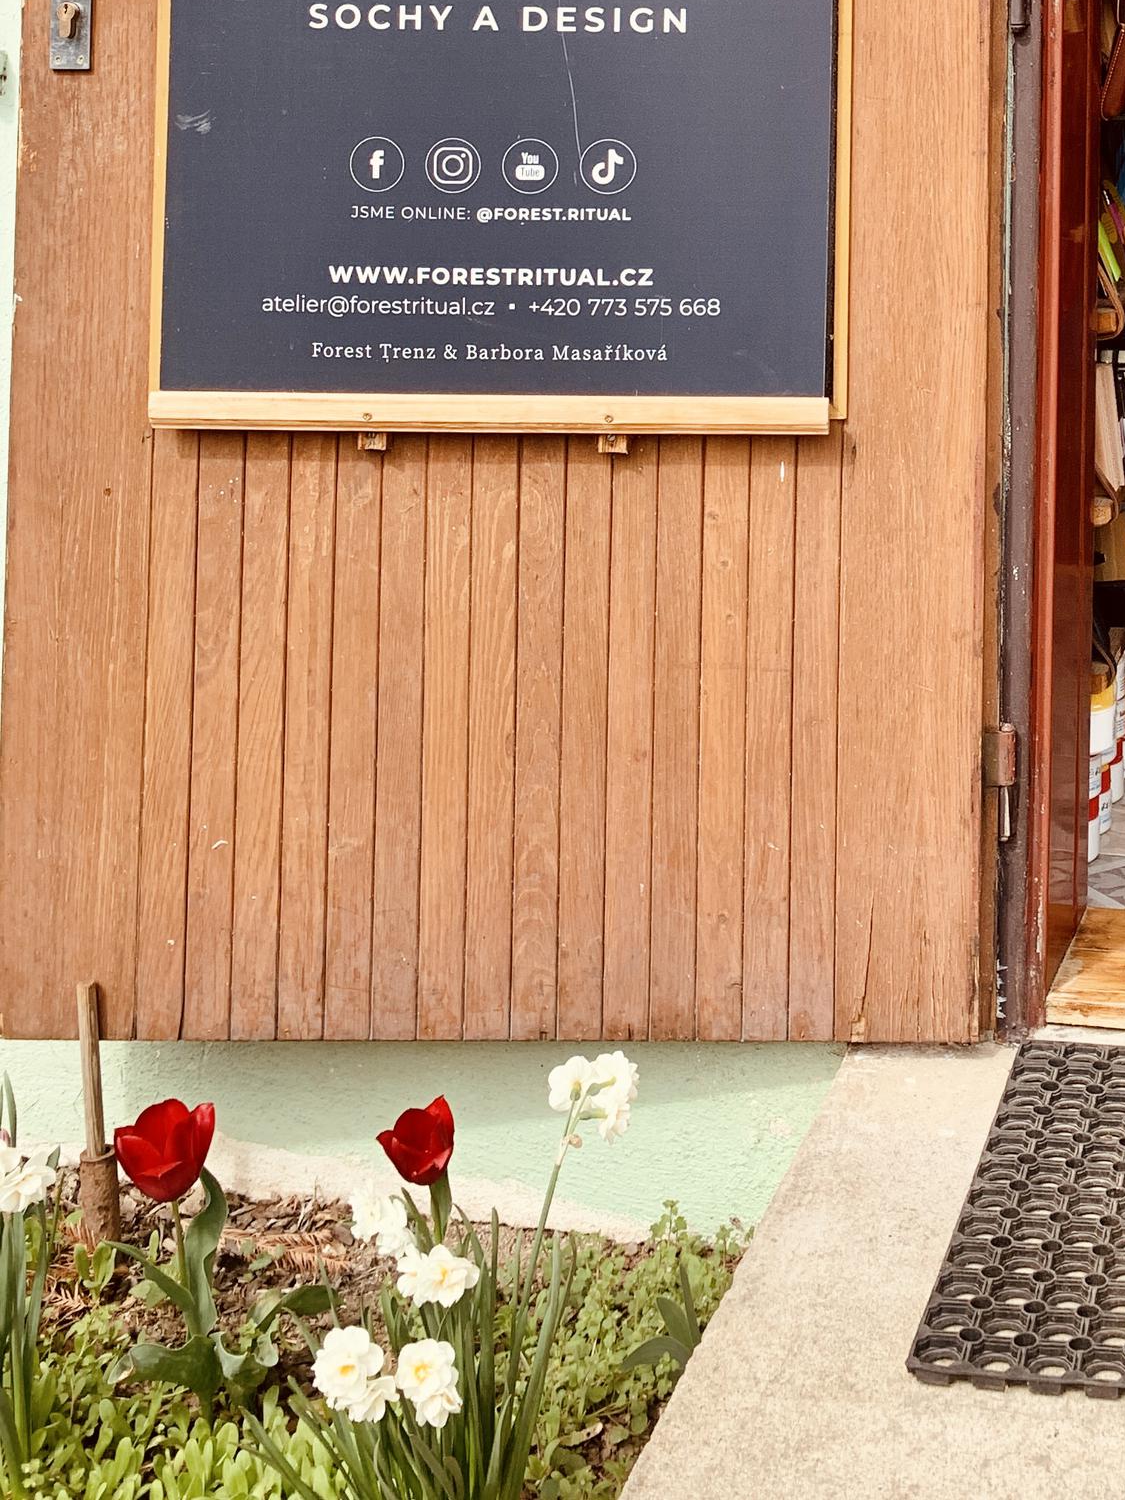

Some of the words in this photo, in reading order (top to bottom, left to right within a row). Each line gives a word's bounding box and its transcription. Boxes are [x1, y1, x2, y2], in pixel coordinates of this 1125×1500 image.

[309, 4, 452, 30] SOCHY
[473, 6, 498, 30] A
[523, 7, 686, 33] DESIGN
[521, 152, 540, 164] You
[521, 168, 540, 177] Tube
[351, 206, 394, 218] JSME
[402, 207, 470, 220] ONLINE:
[477, 208, 631, 221] @FOREST.RITUAL
[329, 266, 653, 286] WWW.FORESTRITUAL.CZ
[262, 294, 494, 317] atelier@forestritual.cz
[529, 299, 580, 315] +420
[588, 299, 626, 315] 773
[635, 299, 672, 316] 575
[680, 299, 720, 315] 668
[312, 343, 371, 358] Forest
[380, 344, 435, 360] Trenz
[444, 344, 457, 359] &
[466, 344, 544, 360] Barbora
[553, 345, 667, 360] Masaříková
